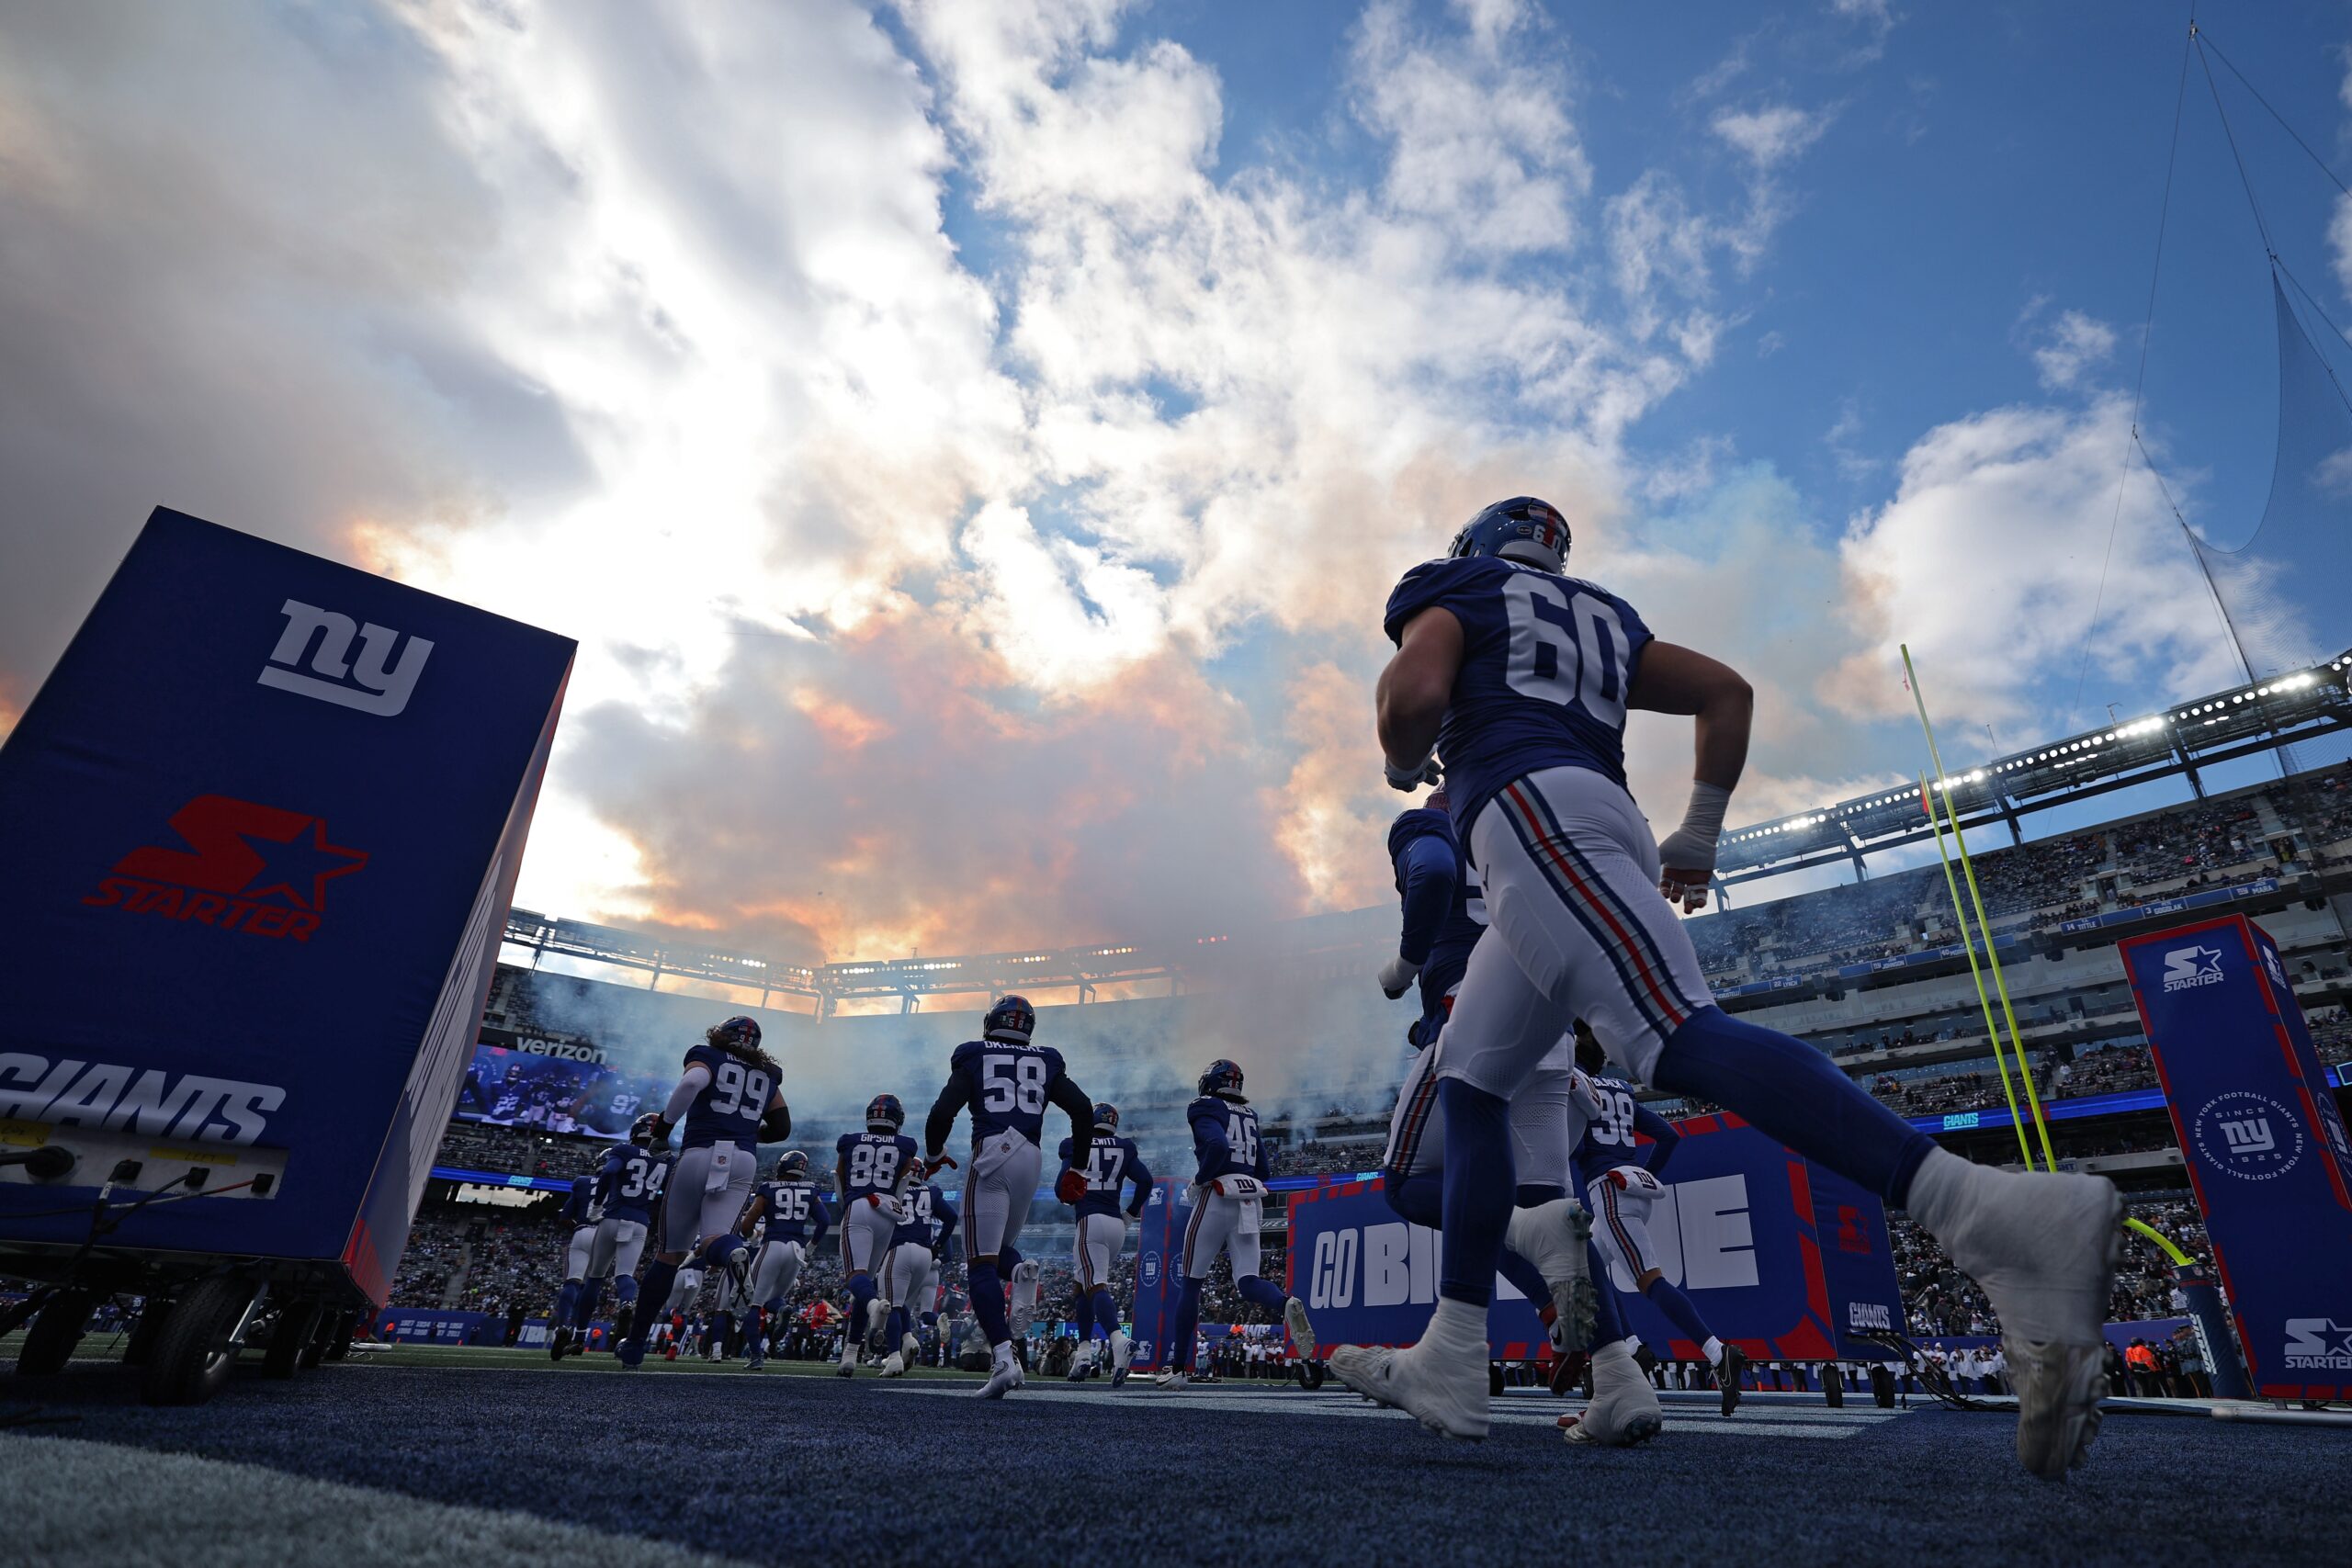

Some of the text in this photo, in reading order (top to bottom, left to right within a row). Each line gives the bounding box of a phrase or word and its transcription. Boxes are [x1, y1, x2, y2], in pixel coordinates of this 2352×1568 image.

[257, 598, 435, 716] ny
[1501, 572, 1630, 729] 60
[82, 878, 322, 942] STARTER
[2077, 921, 2098, 931] TITTLE
[2164, 972, 2224, 993] STARTER
[516, 1036, 608, 1066] verizon
[709, 1062, 770, 1121] 99
[982, 1054, 1046, 1115] 58
[609, 1094, 642, 1116] 97
[2195, 1091, 2299, 1138] NEW YORK FOOTBALL GIANTS
[2214, 1107, 2266, 1119] SINCE
[1943, 1112, 1979, 1129] GIANTS
[860, 1134, 895, 1144] GIPSON
[1091, 1137, 1116, 1146] EWITT
[1226, 1113, 1258, 1167] 46
[2219, 1117, 2276, 1154] ny
[2295, 1133, 2303, 1154] NEW
[850, 1144, 899, 1189] 88
[1086, 1147, 1125, 1190] 47
[2198, 1142, 2224, 1170] GIANTS
[2229, 1153, 2282, 1164] 1925
[2278, 1156, 2300, 1174] YORK
[621, 1157, 668, 1201] 34
[1234, 1179, 1258, 1193] ny
[1356, 1171, 1379, 1182] GIANTS
[2226, 1168, 2278, 1180] FOOTBALL
[775, 1189, 811, 1220] 95
[1310, 1228, 1358, 1309] GO
[1364, 1221, 1443, 1308] BI
[1849, 1302, 1891, 1330] GIANTS
